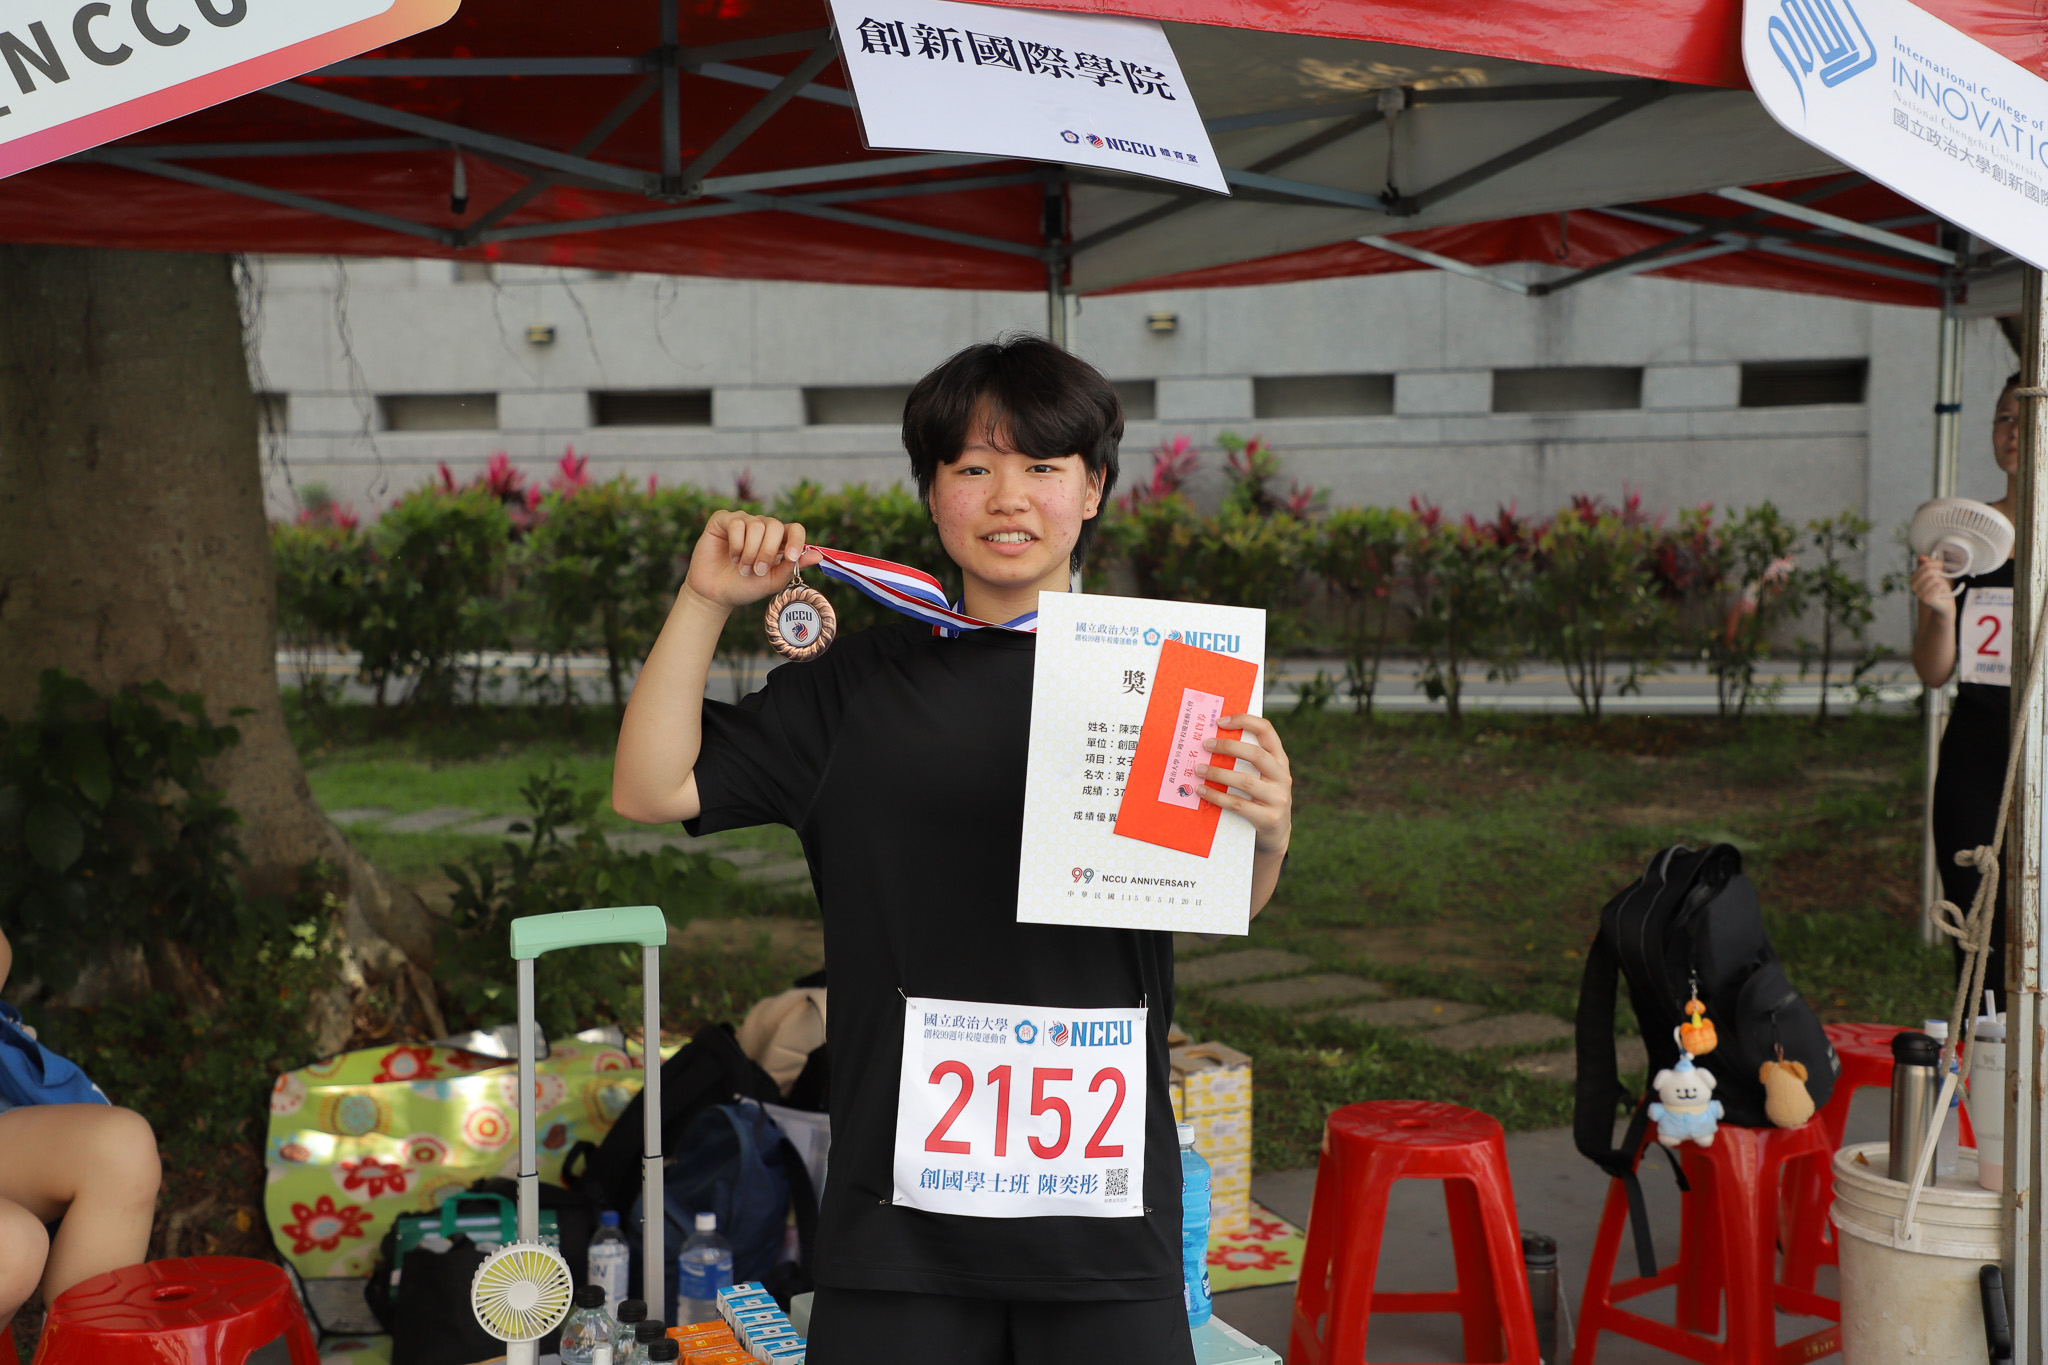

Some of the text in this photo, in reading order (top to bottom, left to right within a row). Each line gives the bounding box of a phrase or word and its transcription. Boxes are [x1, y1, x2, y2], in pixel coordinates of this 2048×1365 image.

[0, 0, 247, 112] NCC
[855, 17, 1176, 101] 創新國際學院
[1894, 35, 2044, 131] International College of
[1105, 136, 1156, 157] NCCU
[1894, 89, 2043, 182] National Chengchi University
[785, 611, 812, 622] NCCU
[1076, 622, 1139, 637] 國立政治大學
[1185, 631, 1240, 653] NCCU
[1122, 670, 1146, 696] 獎
[1088, 722, 1142, 735] 姓名：陳奕
[1071, 867, 1196, 889] 99 NCCU ANNIVERSARY
[924, 1012, 1008, 1031] 國立政治大學
[1070, 1020, 1133, 1047] NCCU
[924, 1028, 1007, 1045] 創校99週年校慶運動會
[924, 1060, 1127, 1160] 2152
[919, 1167, 1099, 1196] 創國學士班 陳奕彤
